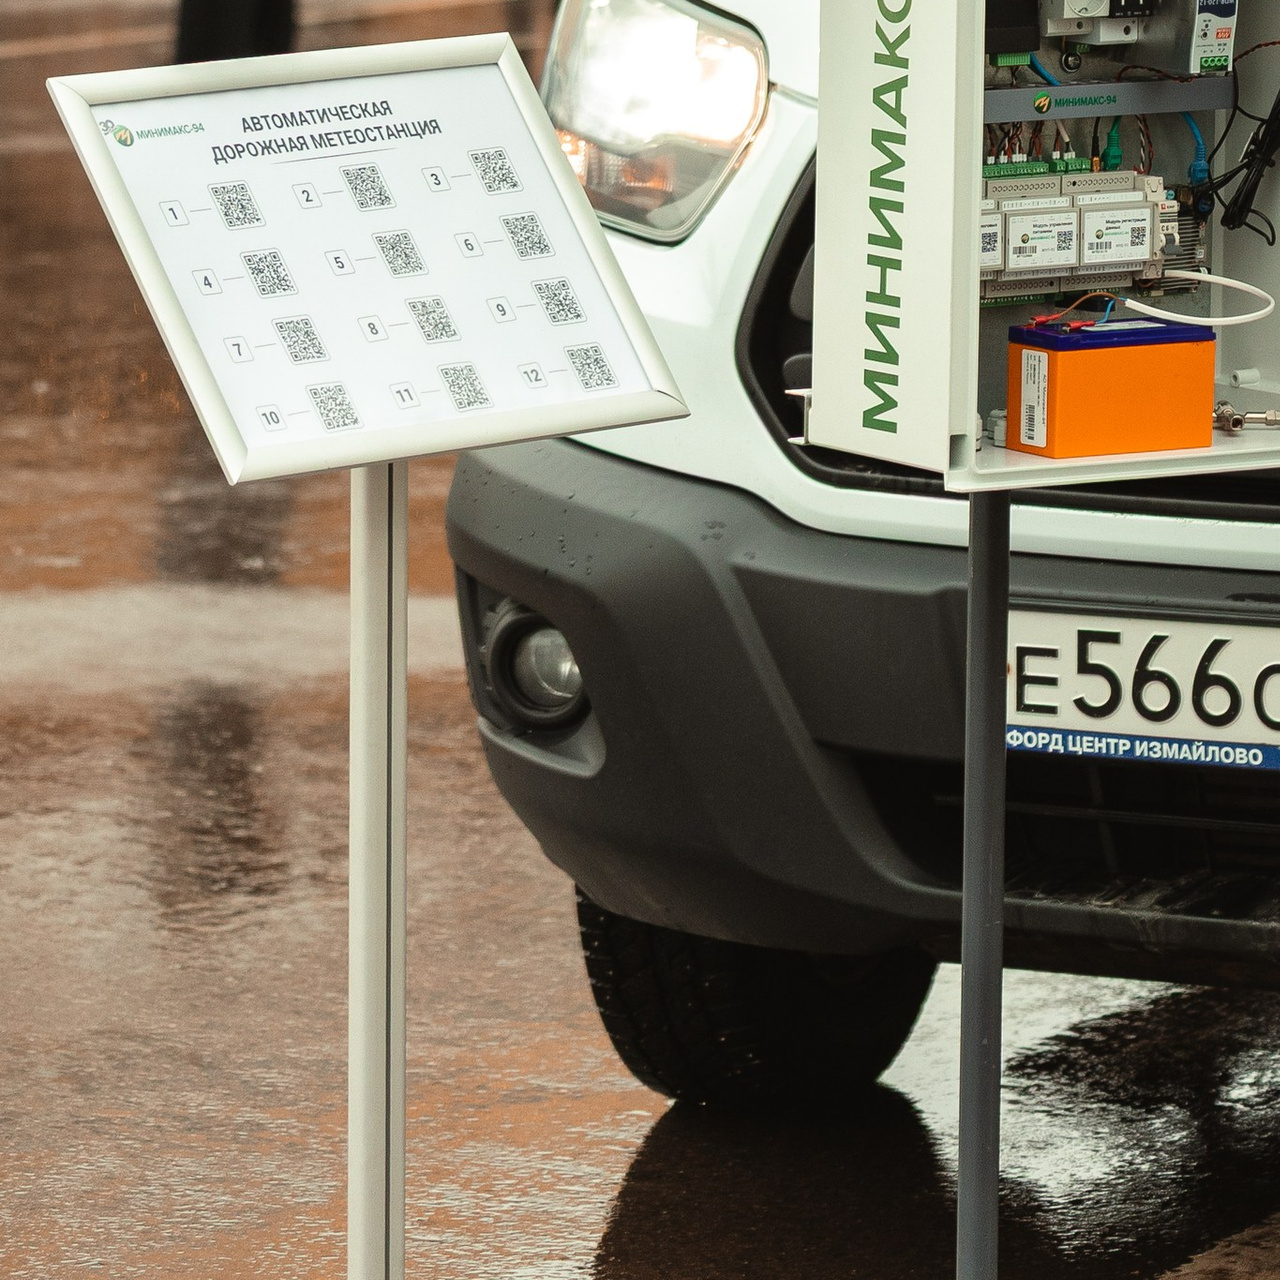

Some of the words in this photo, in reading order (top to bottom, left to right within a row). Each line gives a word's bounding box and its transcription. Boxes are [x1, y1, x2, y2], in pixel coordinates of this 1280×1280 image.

[1054, 94, 1117, 108] МИНИМАКС-94
[241, 100, 393, 134] АВТОМАТИЧЕСКАЯ
[136, 123, 205, 140] МИНИМАКС-94
[211, 134, 308, 165] ДОРОЖНАЯ
[309, 118, 442, 150] МЕТЕОСТАНЦИЯ
[430, 173, 441, 186] 3
[301, 189, 314, 203] 2
[168, 207, 178, 220] 1
[463, 238, 475, 252] 6
[333, 256, 345, 269] 5
[203, 275, 213, 289] 4
[496, 303, 507, 317] 9
[367, 322, 379, 336] 8
[232, 343, 242, 357] 7
[523, 368, 543, 383] 12
[395, 388, 414, 403] 11
[261, 411, 280, 426] 10
[1006, 730, 1064, 754] ФОРД
[1068, 736, 1131, 756] ЦЕНТР
[1135, 741, 1263, 766] ИЗМАЙЛОВО
